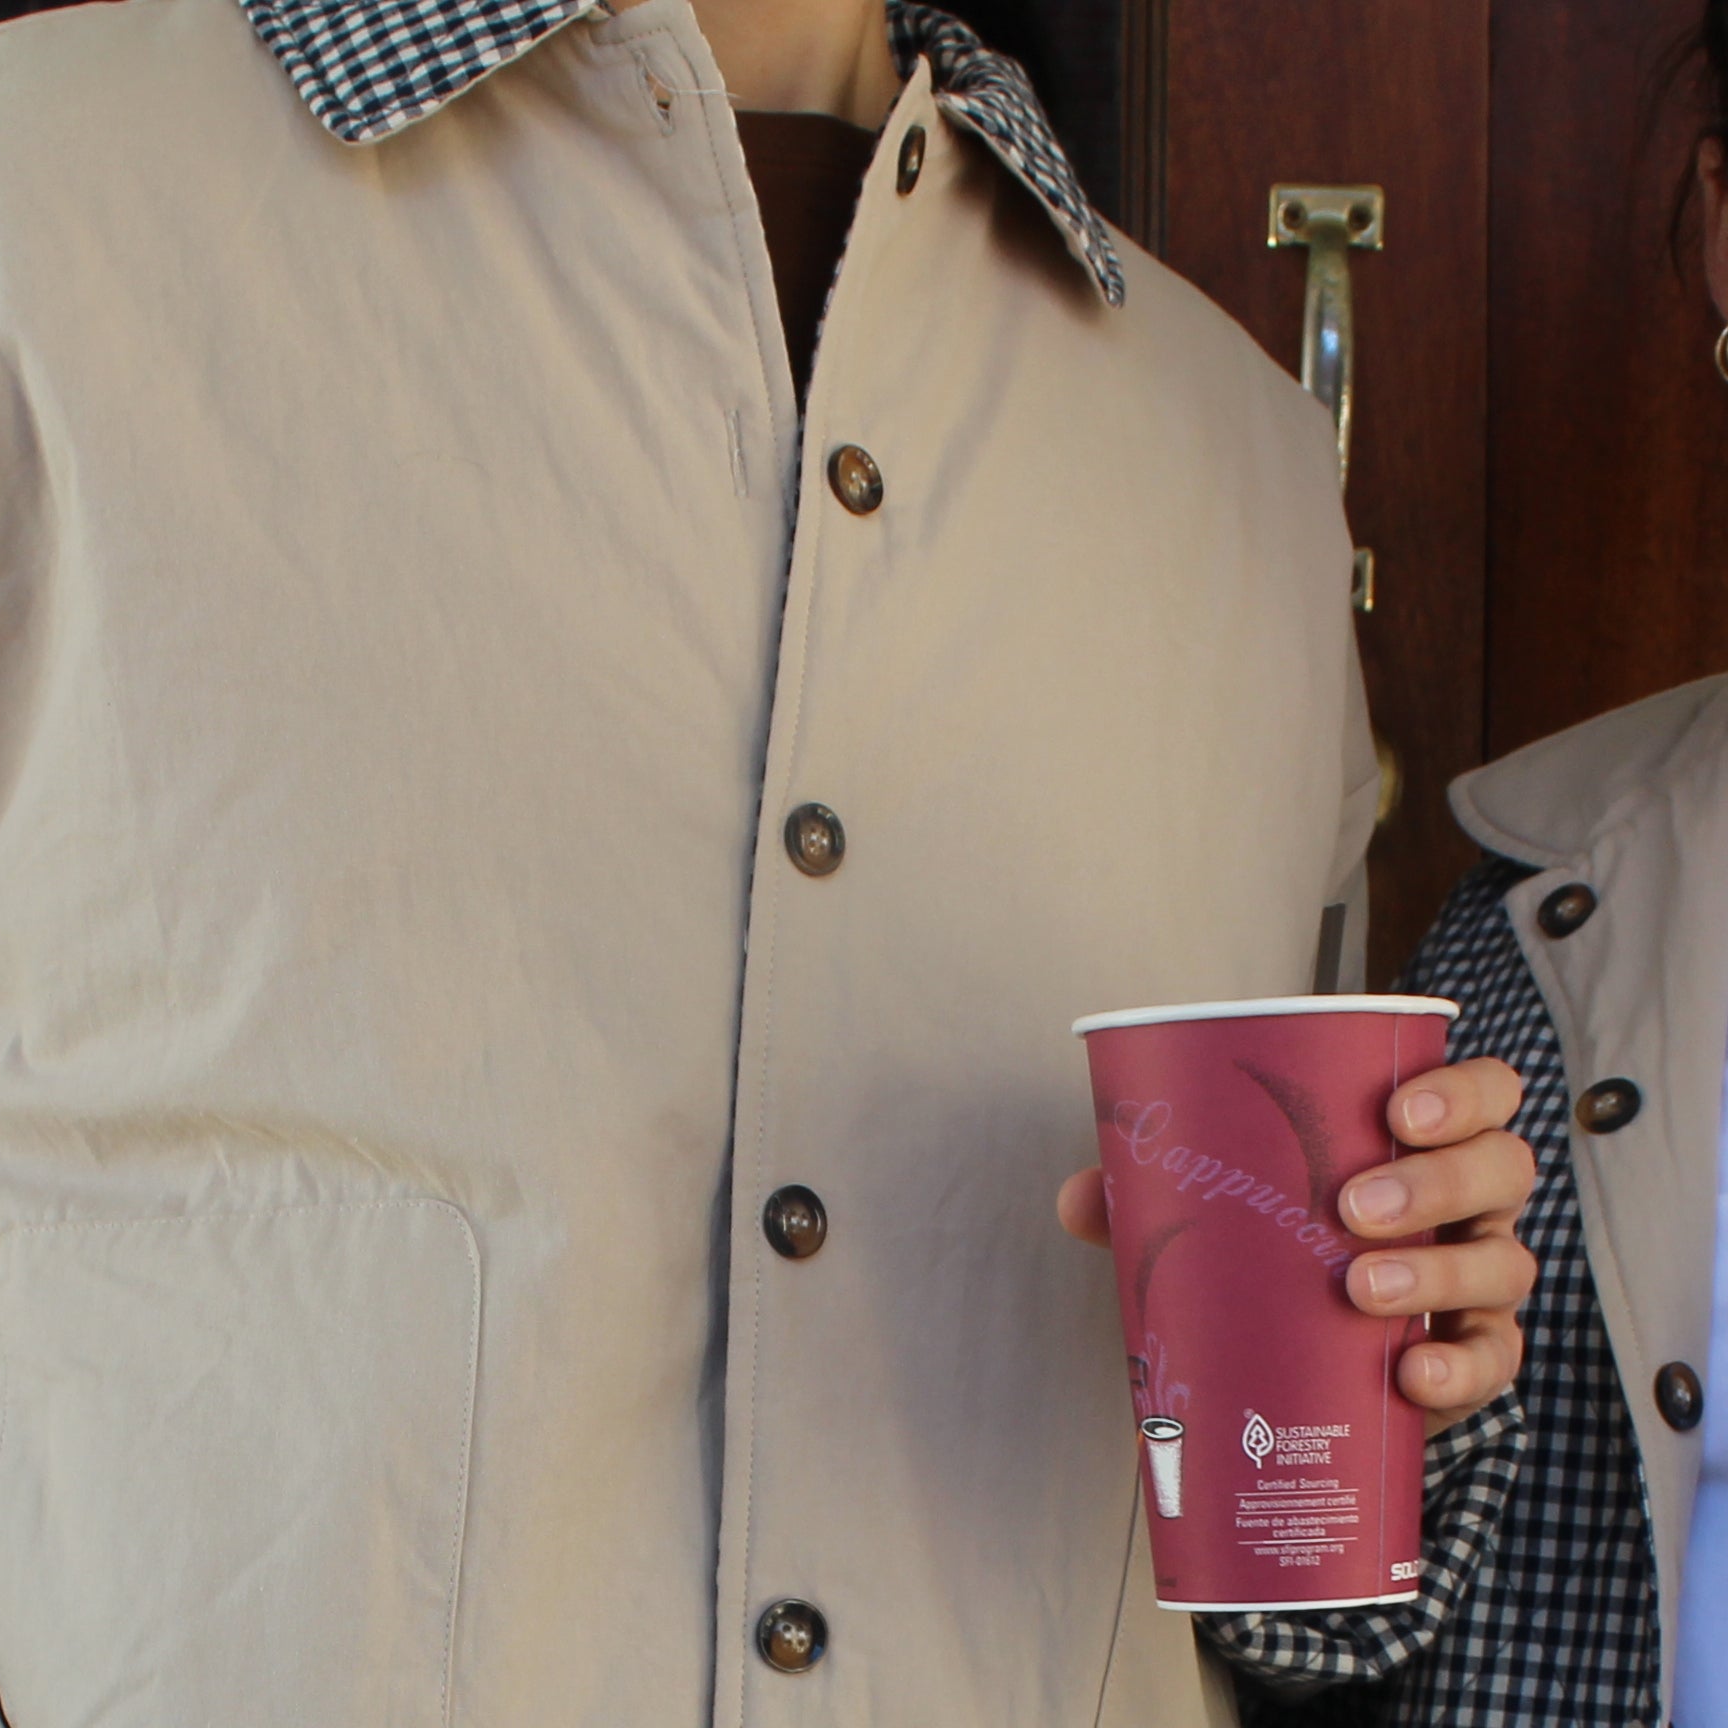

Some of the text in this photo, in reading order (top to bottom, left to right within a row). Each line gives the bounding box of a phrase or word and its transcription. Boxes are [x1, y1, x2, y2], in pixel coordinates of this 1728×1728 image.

[1113, 1099, 1352, 1279] Cappuccin
[1276, 1424, 1351, 1438] SUSTAINABLE
[1276, 1439, 1331, 1452] FORESTRY
[1276, 1452, 1332, 1466] INITIATIVE
[1257, 1478, 1340, 1490] Certified Sourcing
[1235, 1514, 1360, 1528] Fuente de abastecimiento
[1273, 1527, 1326, 1538] certificada
